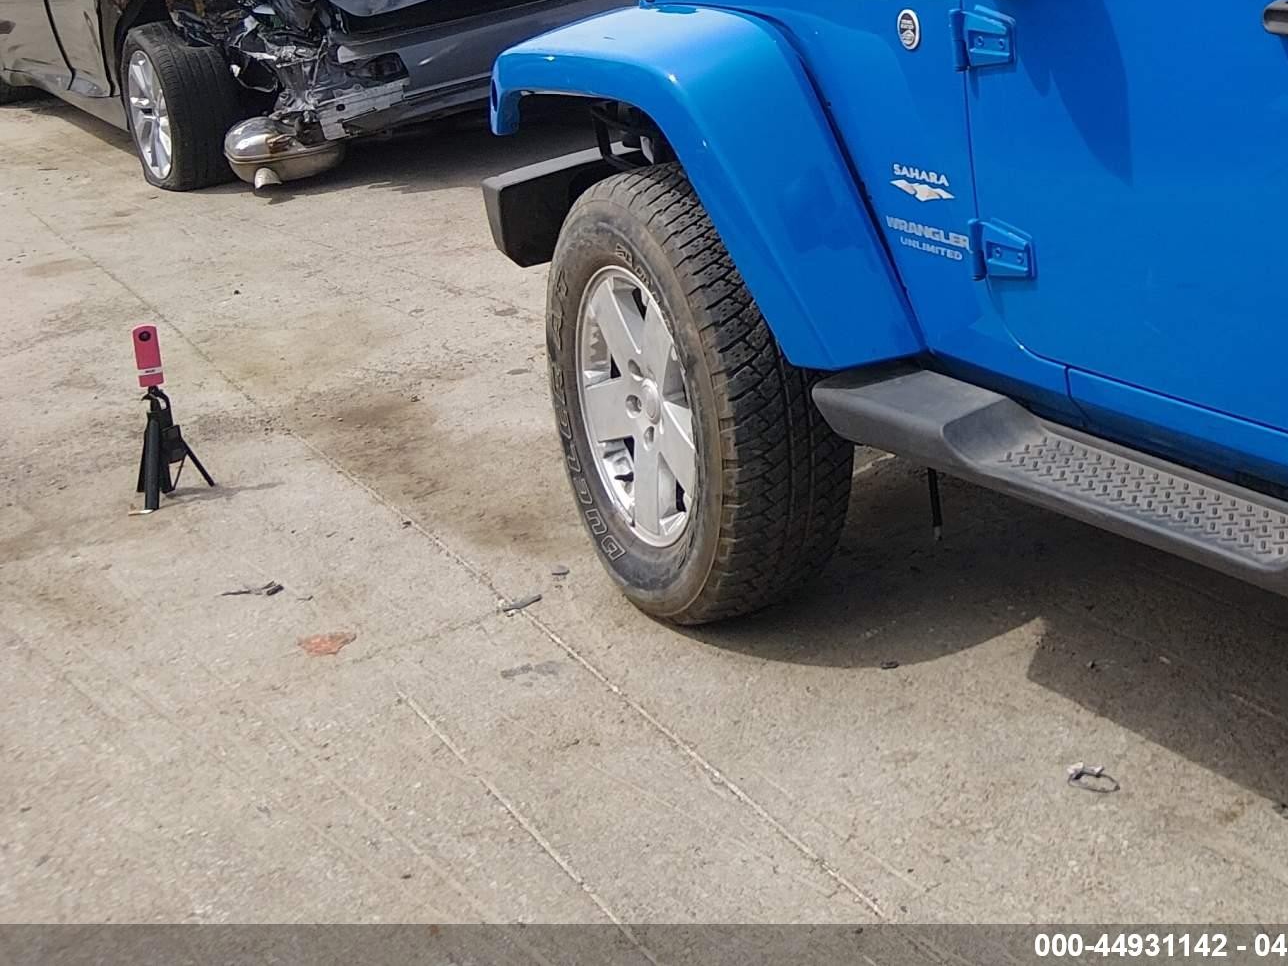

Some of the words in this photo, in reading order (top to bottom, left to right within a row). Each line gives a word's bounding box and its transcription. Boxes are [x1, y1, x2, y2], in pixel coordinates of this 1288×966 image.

[893, 163, 950, 187] SAHARA
[886, 215, 973, 252] WRANGLER
[900, 236, 963, 262] UNLIMITED
